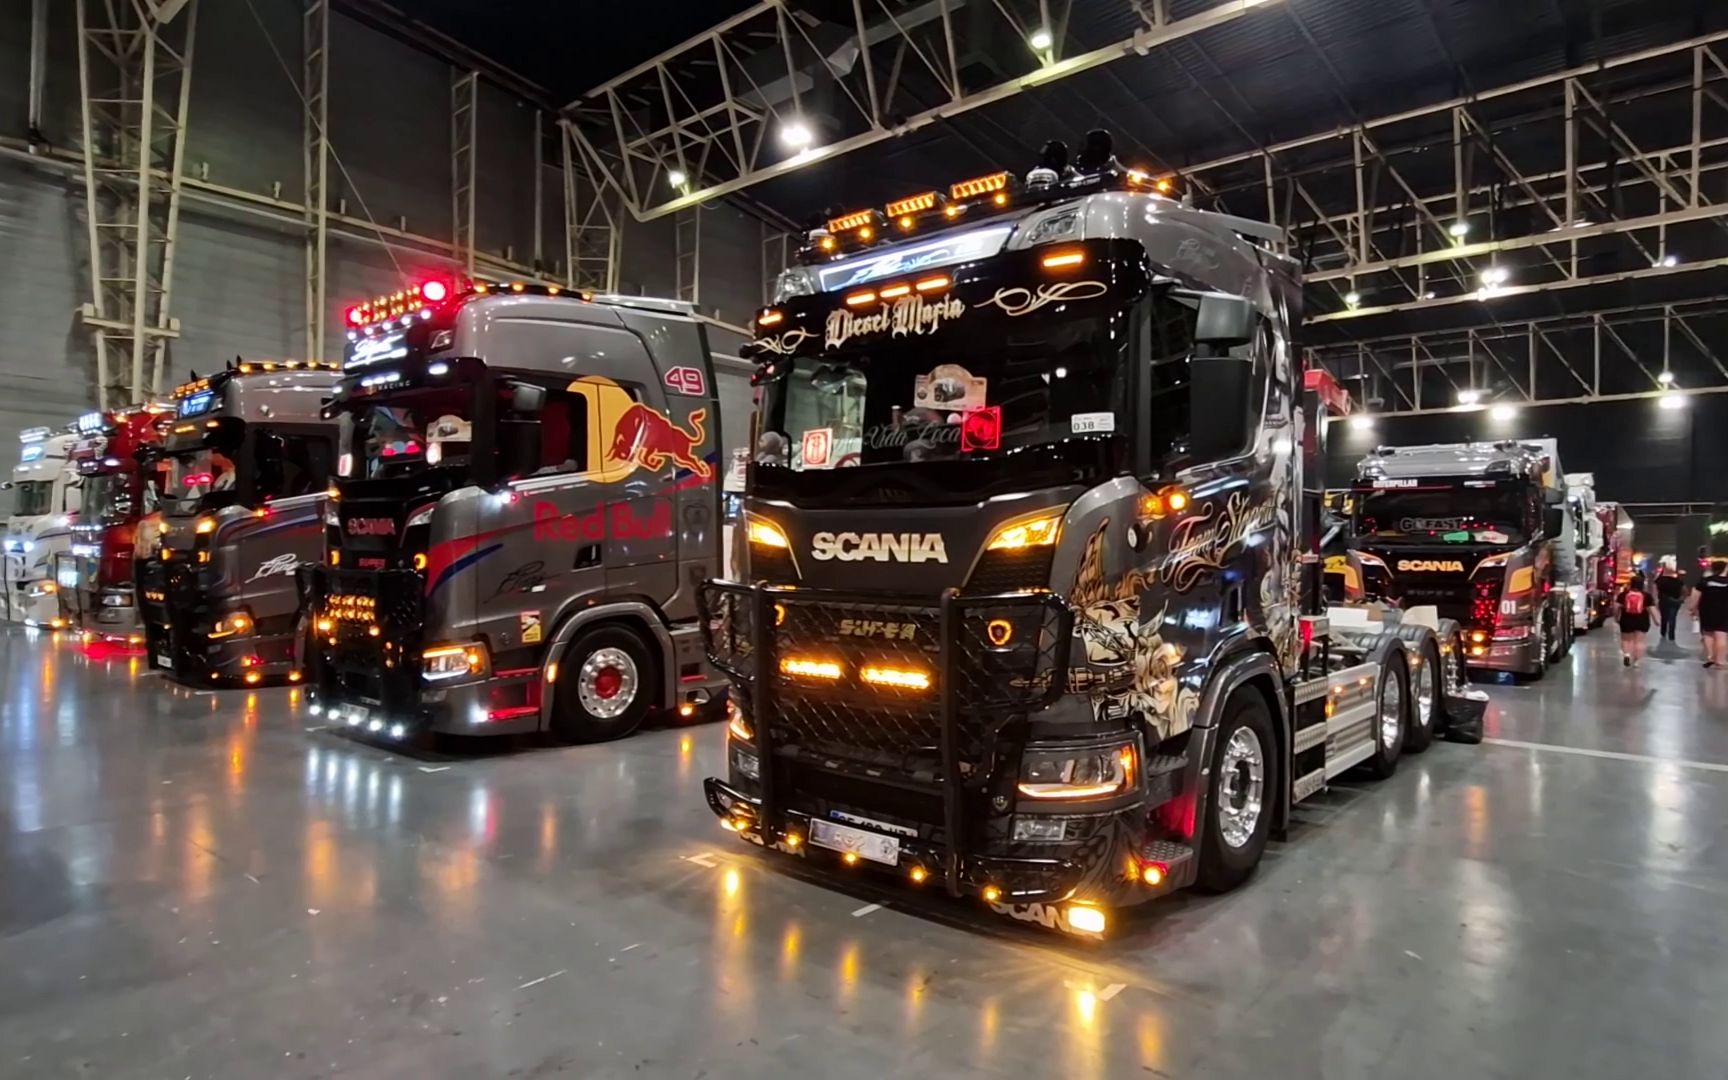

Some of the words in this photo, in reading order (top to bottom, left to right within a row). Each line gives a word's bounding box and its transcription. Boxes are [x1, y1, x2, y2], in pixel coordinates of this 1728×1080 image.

[825, 301, 890, 350] Diesel
[891, 292, 965, 339] Mafia
[664, 366, 705, 395] 49
[347, 518, 396, 535] SCANIA
[533, 502, 605, 541] Red
[612, 500, 672, 539] Bull
[811, 532, 949, 563] SCANIA
[1397, 560, 1465, 571] SCANIA
[1501, 600, 1517, 614] 01
[839, 619, 917, 641] SUPER
